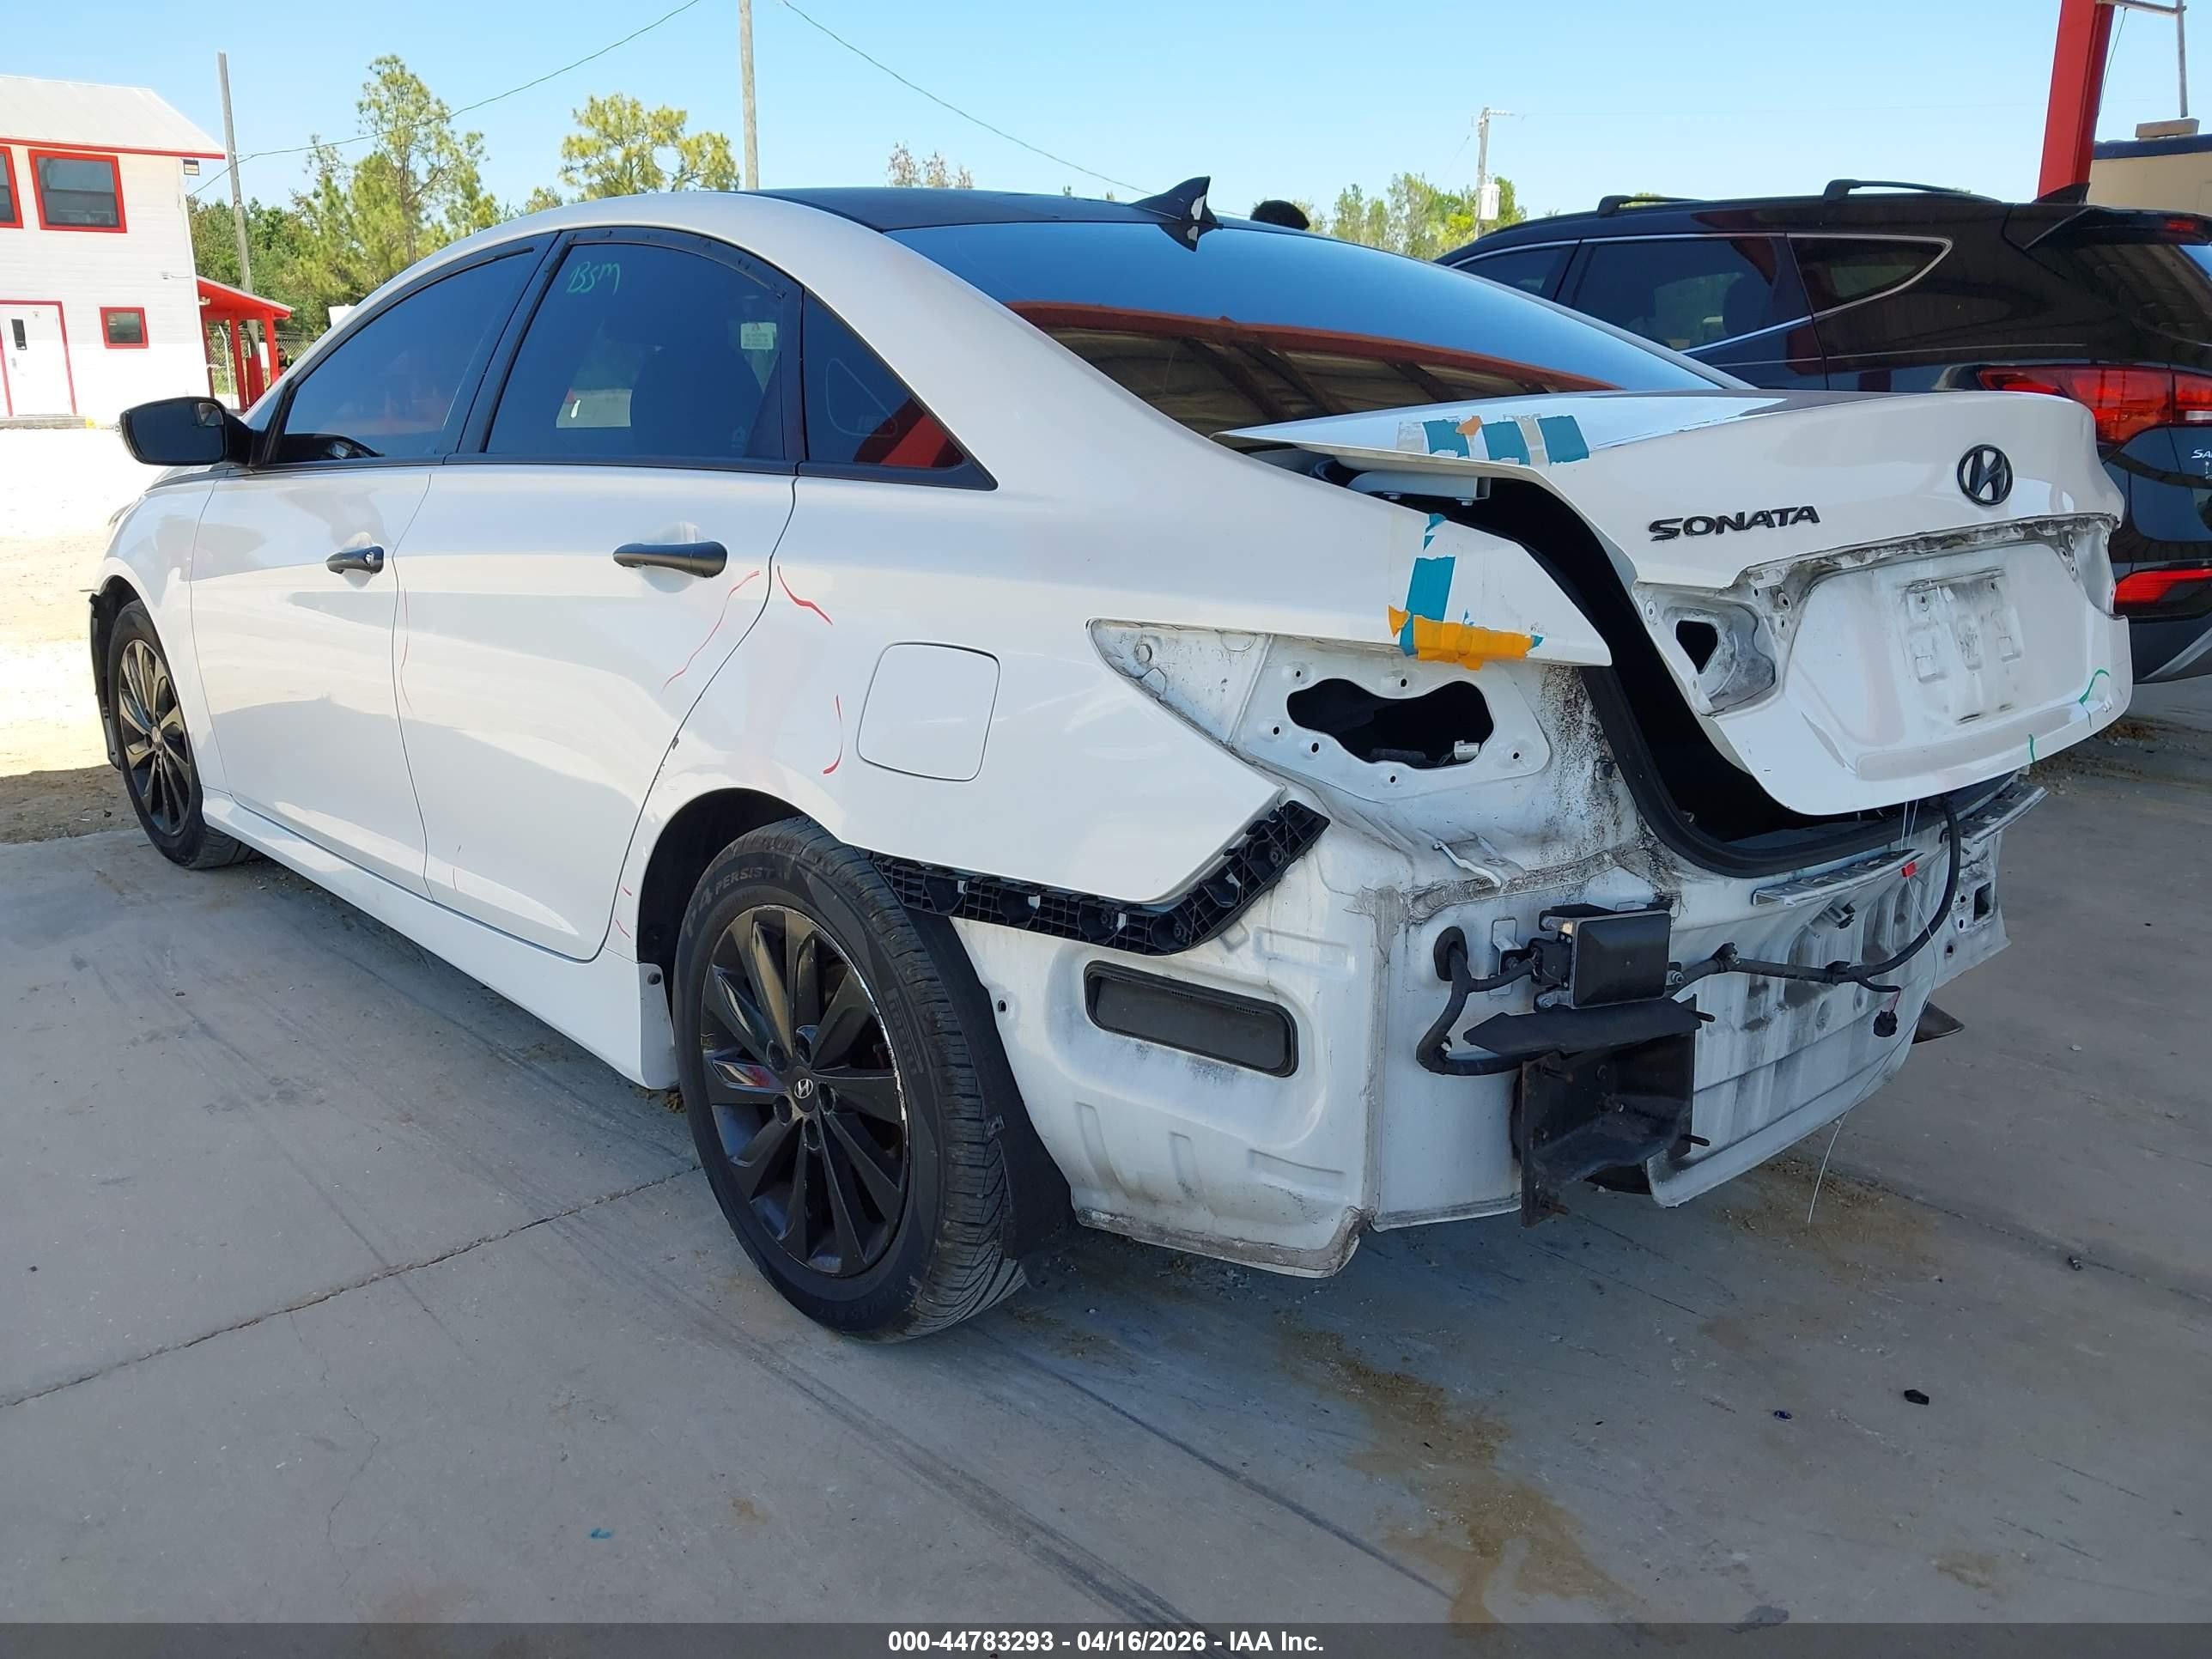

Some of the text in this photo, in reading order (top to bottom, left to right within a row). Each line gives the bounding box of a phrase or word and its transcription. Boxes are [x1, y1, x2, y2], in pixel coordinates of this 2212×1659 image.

[2191, 448, 2212, 459] SA
[1649, 506, 1820, 542] SONATA
[714, 866, 775, 895] PERSIST
